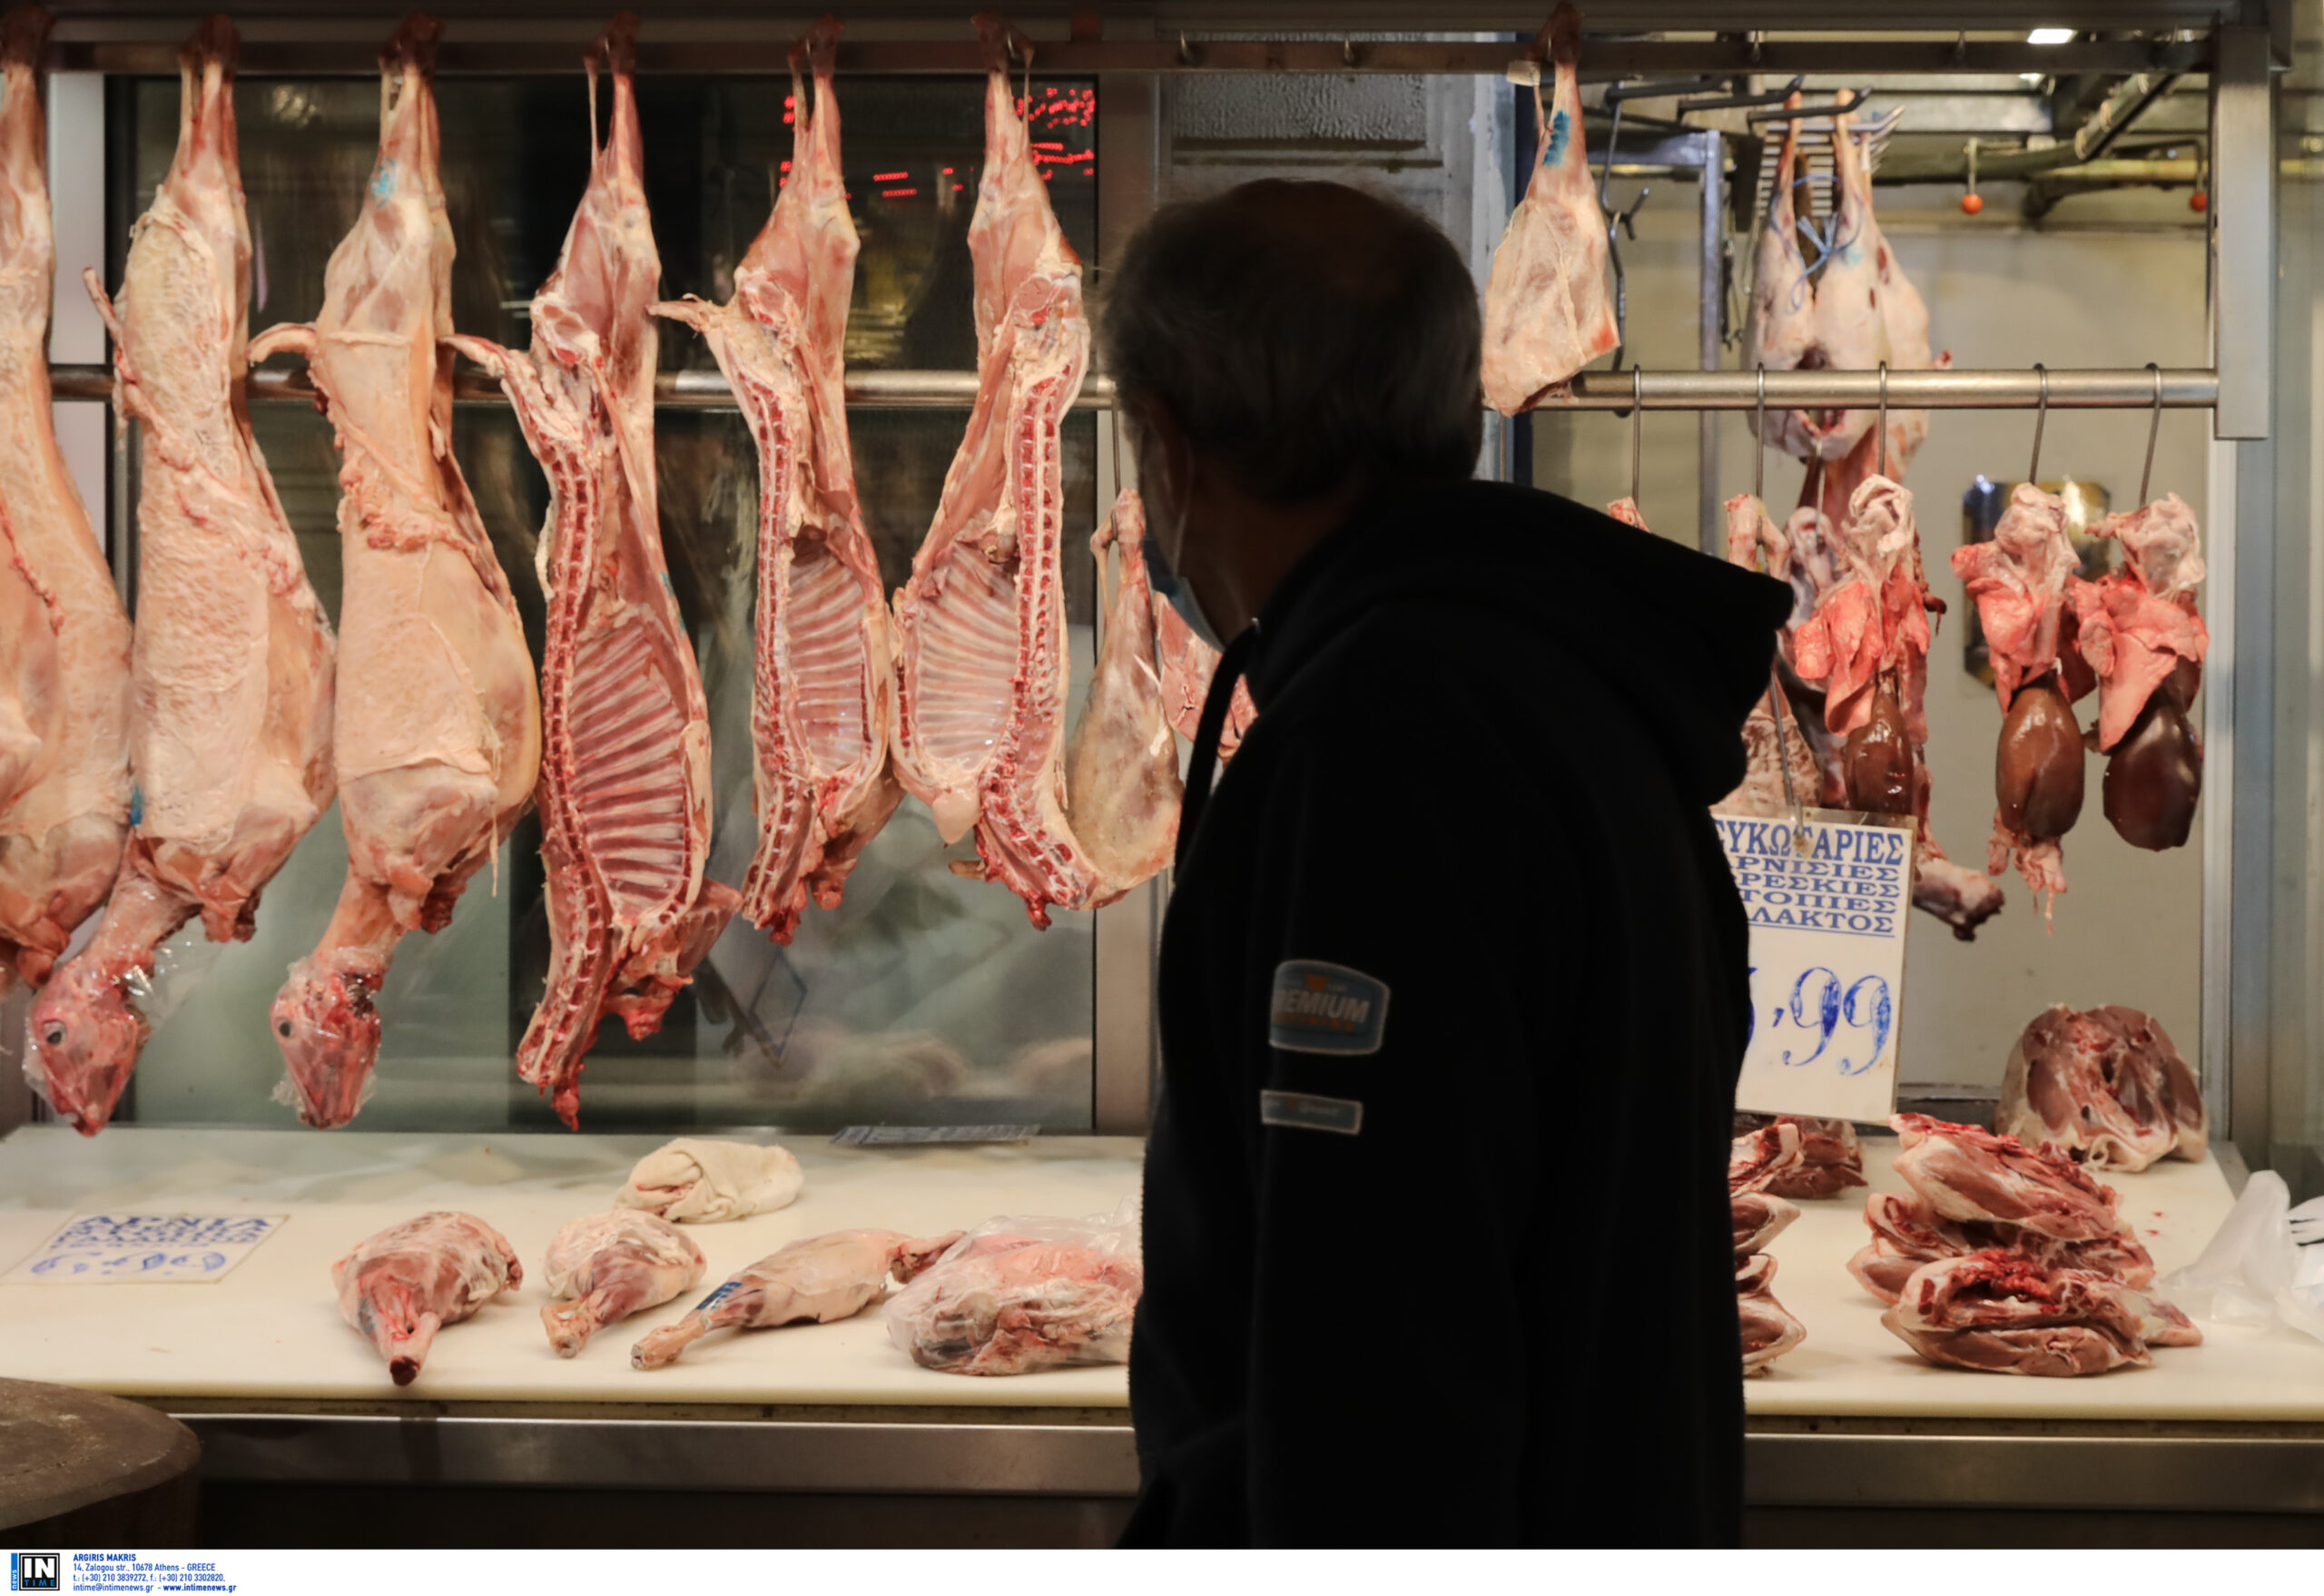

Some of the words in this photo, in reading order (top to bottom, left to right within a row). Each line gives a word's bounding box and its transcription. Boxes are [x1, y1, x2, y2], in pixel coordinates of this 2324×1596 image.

[1729, 855, 1899, 882] ΡΝΙΣΙΕΣ
[1734, 872, 1900, 898] ΡΕΣΚΙΕΣ
[1274, 989, 1371, 1024] EMIUM
[1748, 966, 1892, 1076] ,99
